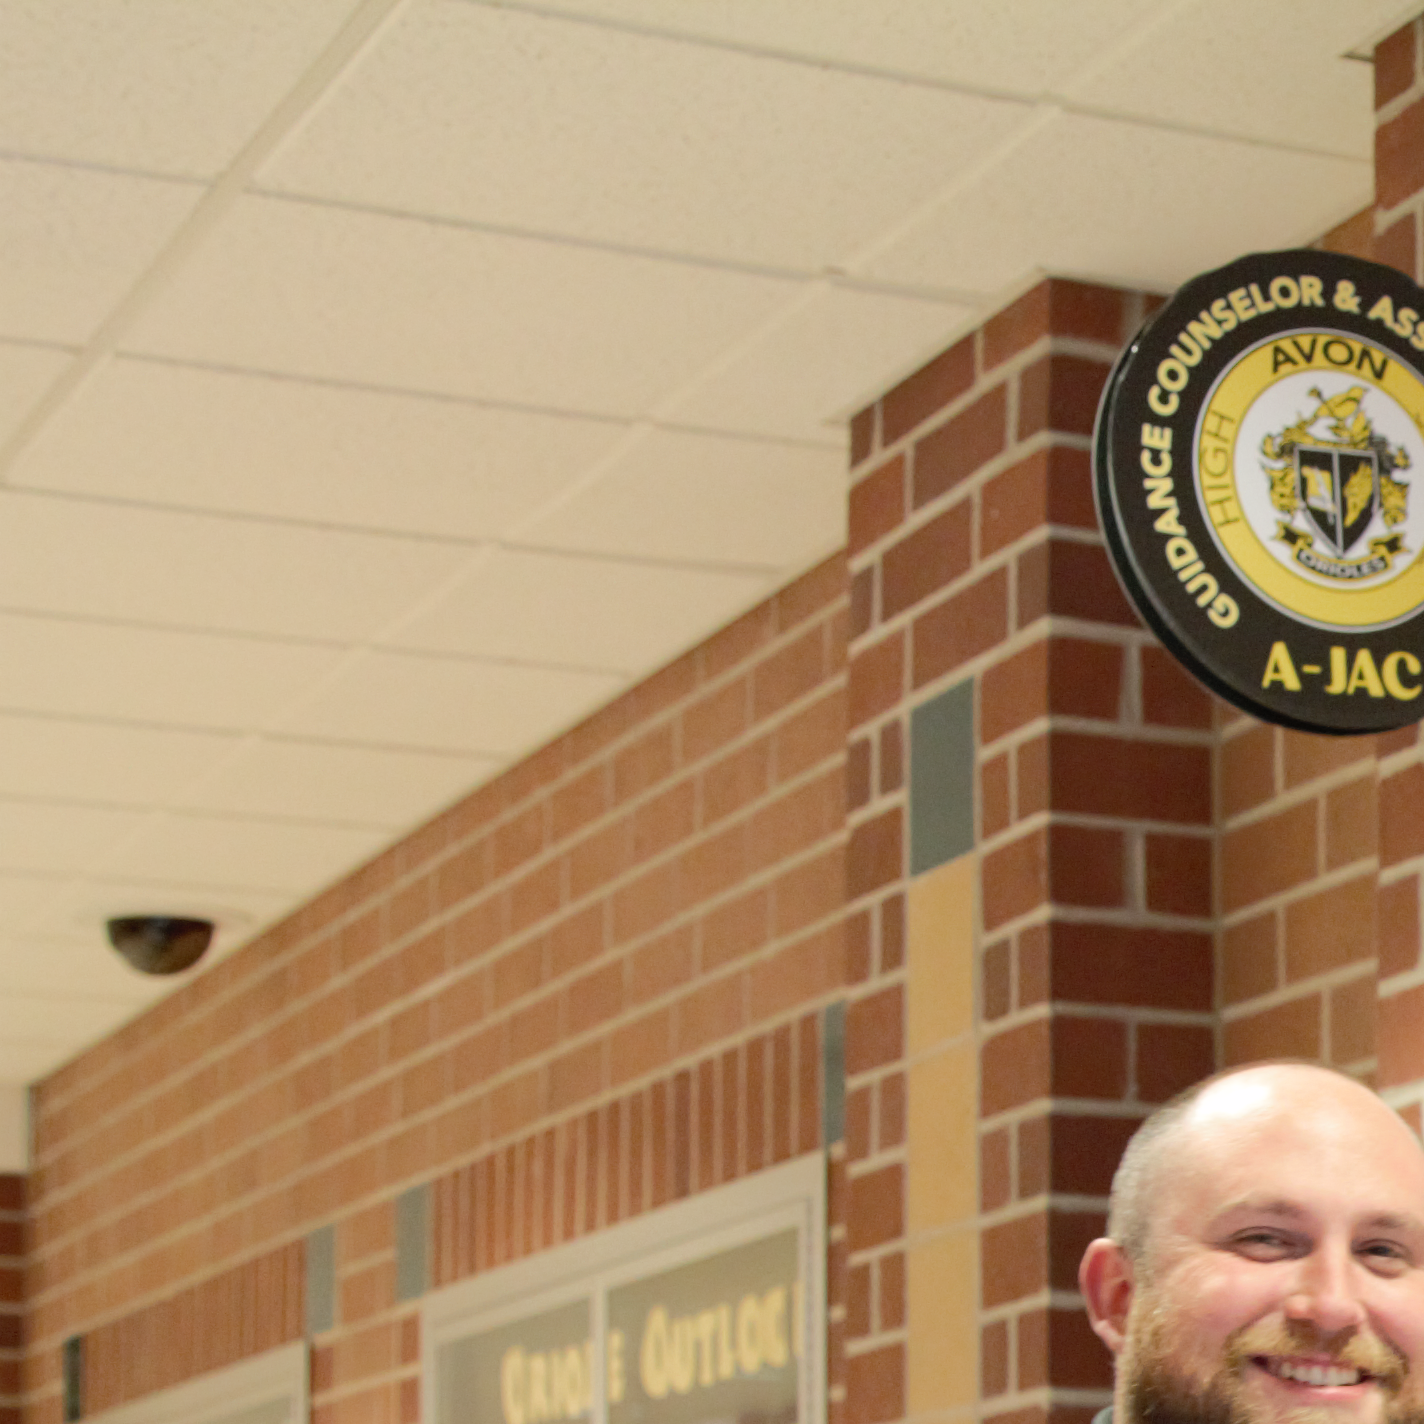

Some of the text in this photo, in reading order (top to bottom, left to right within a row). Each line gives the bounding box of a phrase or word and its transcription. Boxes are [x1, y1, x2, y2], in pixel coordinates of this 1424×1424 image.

[1333, 279, 1361, 314] &
[1148, 275, 1325, 416] COUNSELOR
[1271, 336, 1388, 381] AVON
[1203, 408, 1240, 529] HIGH
[1141, 423, 1240, 629] GUIDANCE
[1261, 640, 1423, 701] A-JAC
